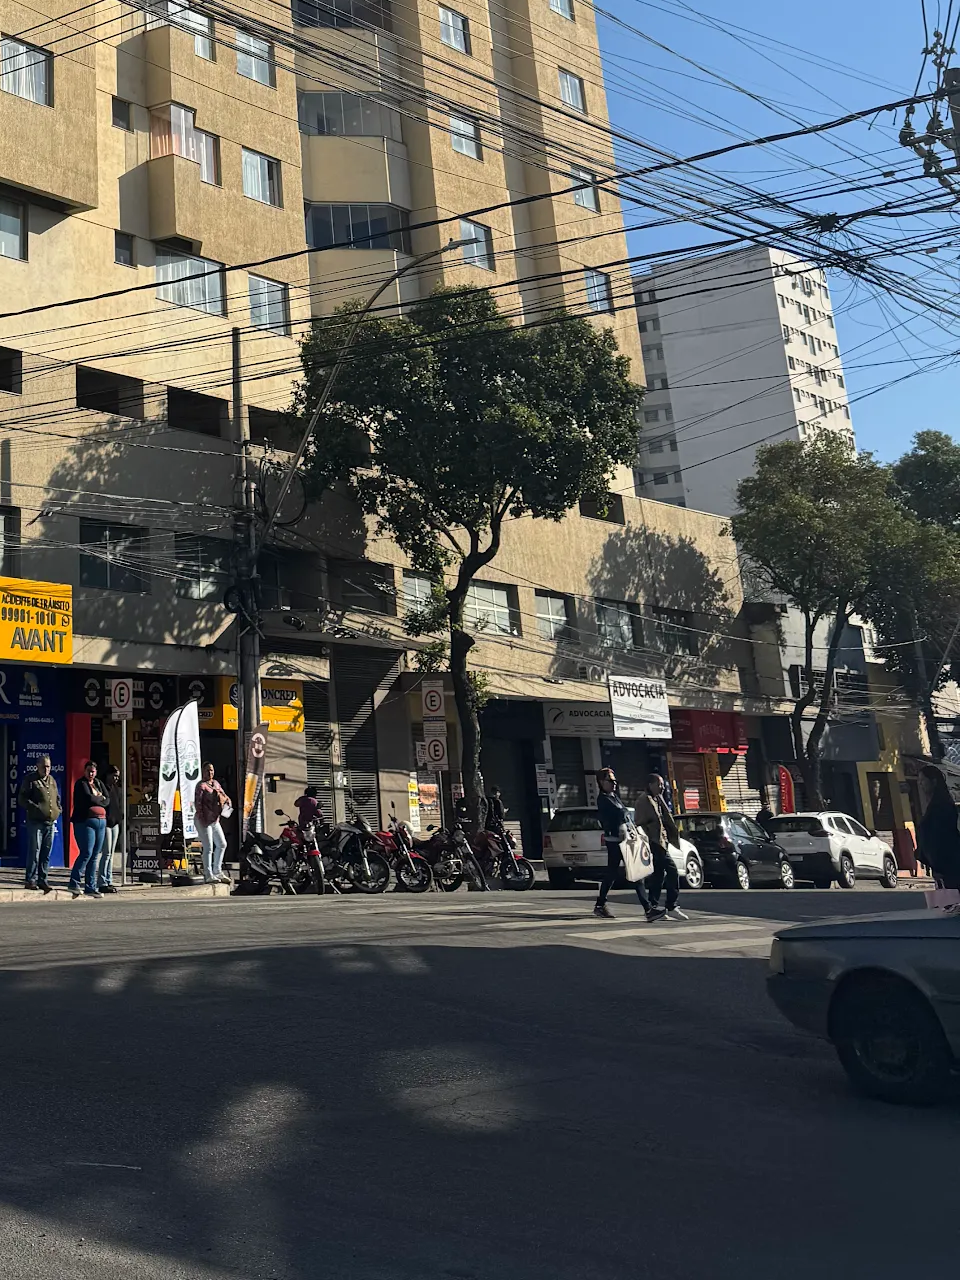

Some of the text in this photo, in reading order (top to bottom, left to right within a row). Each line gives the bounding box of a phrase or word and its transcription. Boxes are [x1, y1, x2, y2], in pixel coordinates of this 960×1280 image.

[10, 627, 67, 653] AVANT
[613, 681, 665, 699] ADVOCACIA
[9, 740, 19, 838] IMÓVEIS
[132, 859, 160, 869] XEROX
